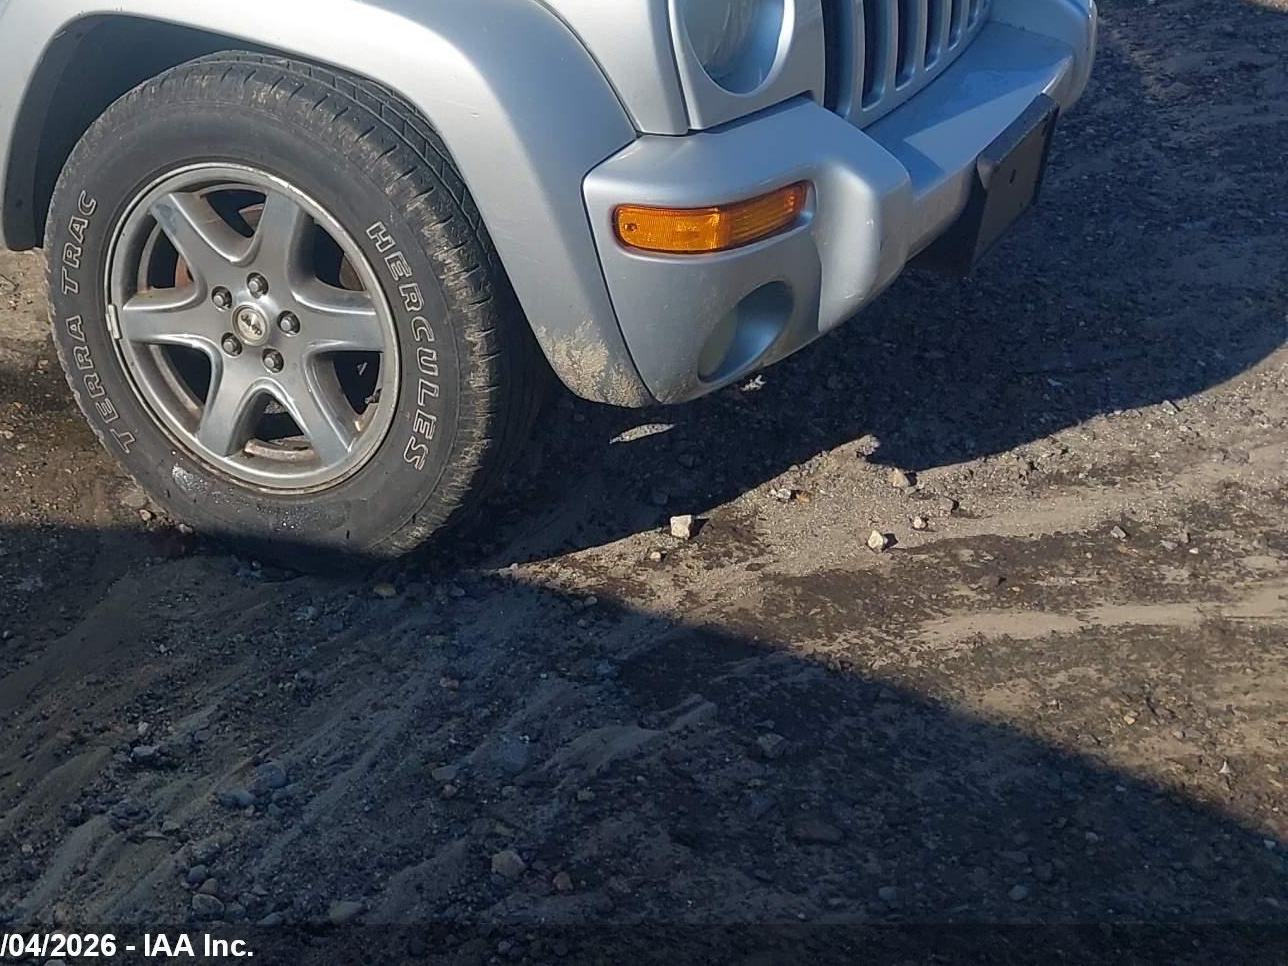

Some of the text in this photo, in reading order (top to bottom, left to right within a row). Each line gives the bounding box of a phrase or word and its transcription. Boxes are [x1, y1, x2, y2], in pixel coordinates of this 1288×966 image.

[62, 190, 136, 454] TERRA TRAC
[240, 313, 263, 336] Jeep
[365, 221, 440, 471] HERCULES
